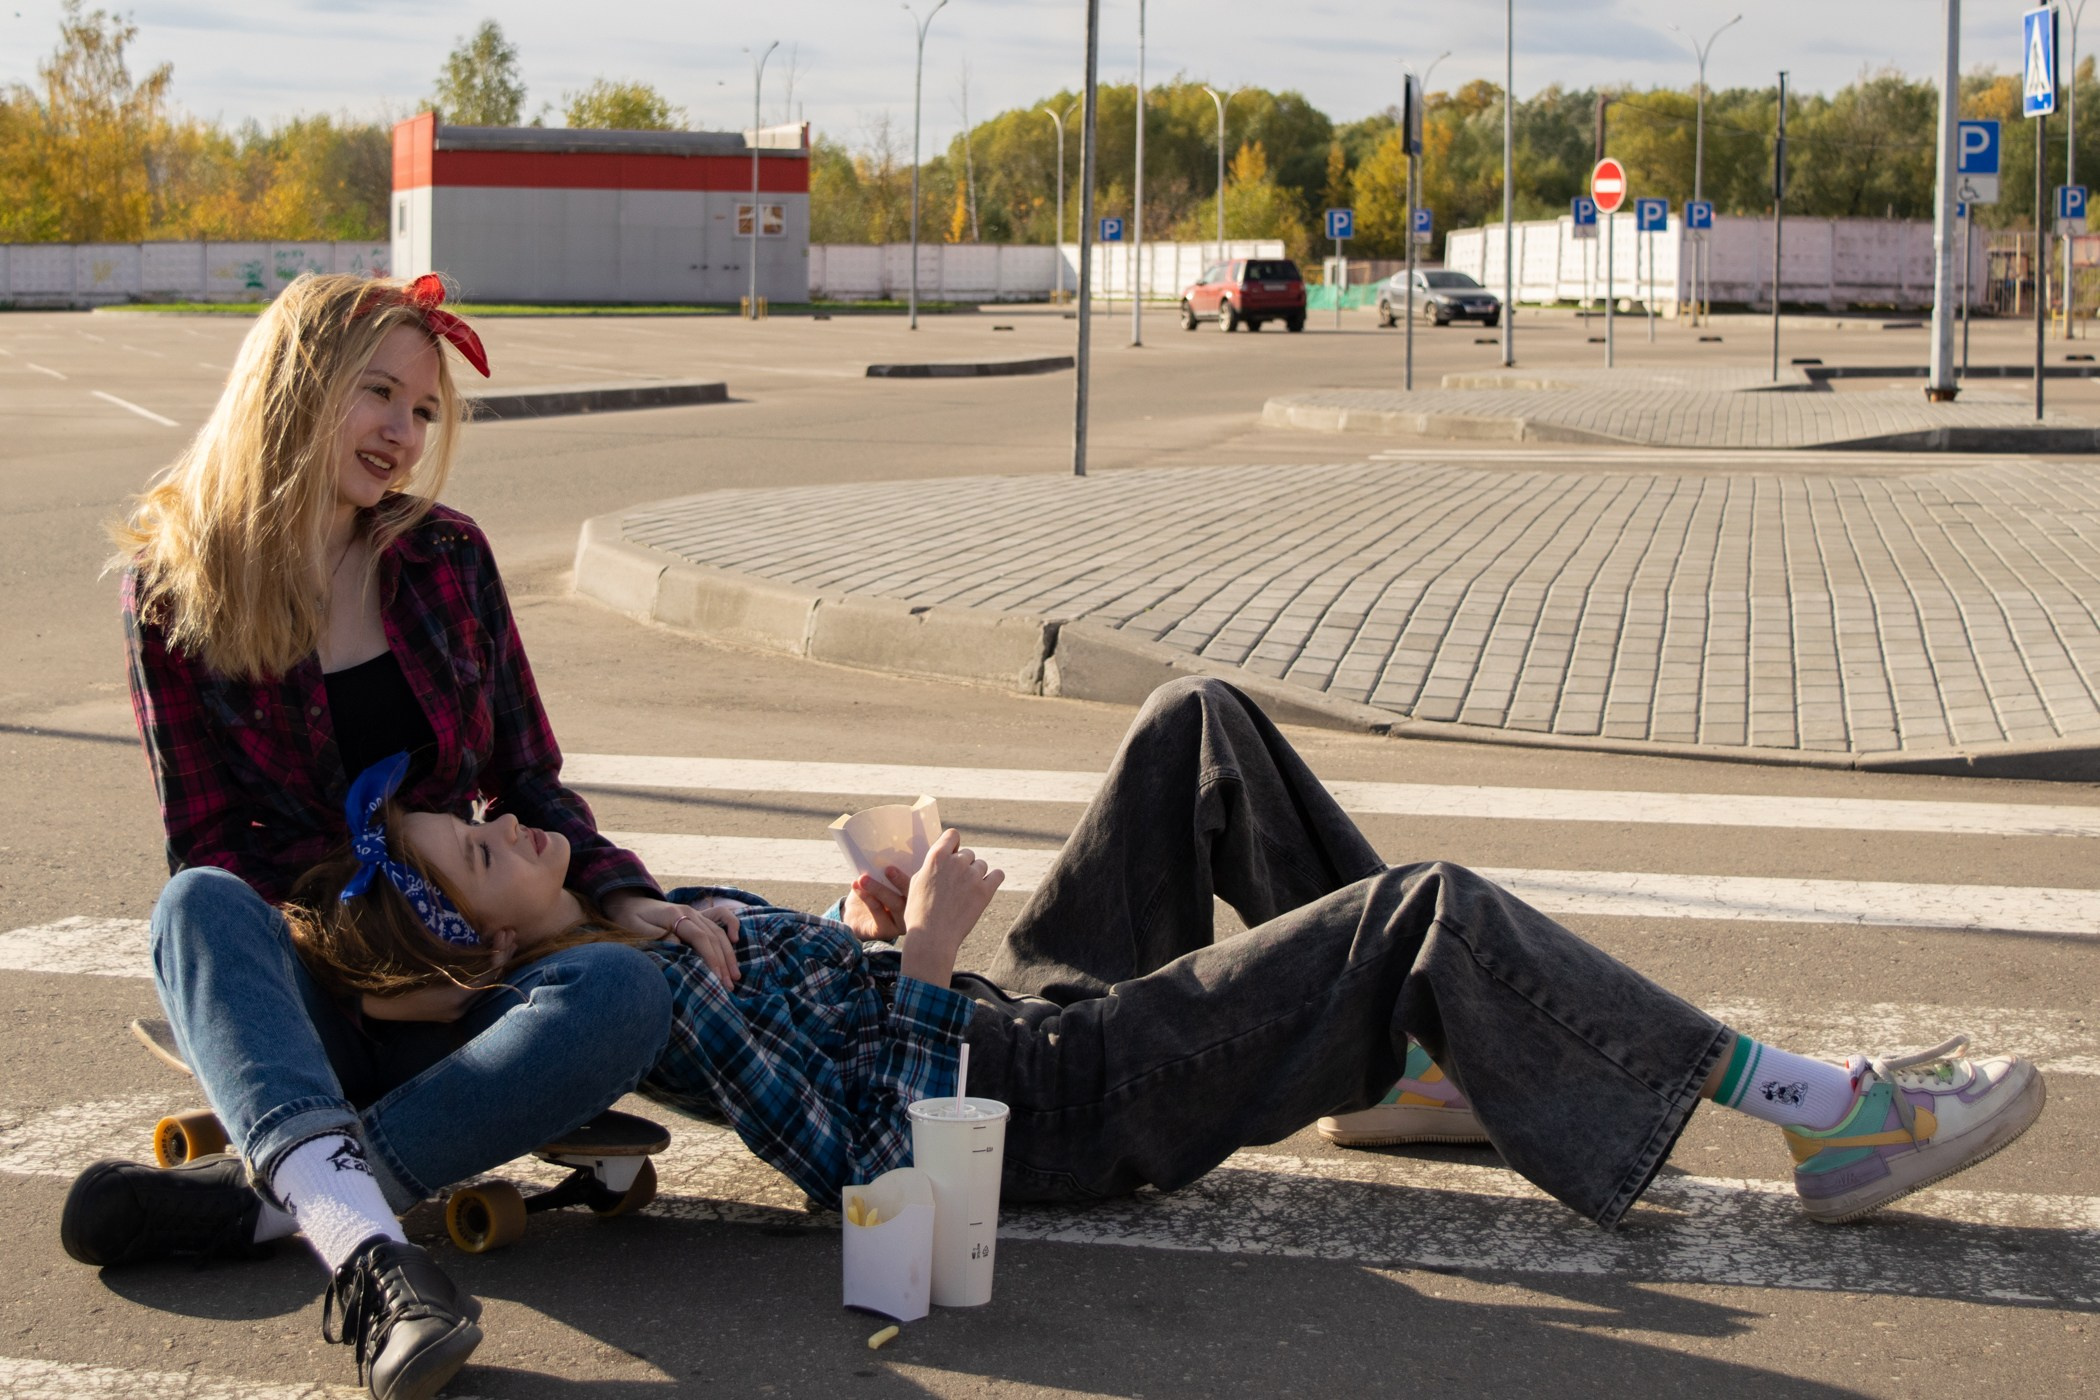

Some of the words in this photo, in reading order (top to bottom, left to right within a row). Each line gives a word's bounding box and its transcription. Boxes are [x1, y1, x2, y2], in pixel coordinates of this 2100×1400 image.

[1959, 125, 1990, 169] P
[1579, 201, 1593, 223] P
[2066, 189, 2082, 216] P
[1333, 213, 1349, 237] P
[1414, 212, 1428, 230] P
[1643, 202, 1662, 229] P
[1693, 204, 1708, 227] P
[1104, 220, 1119, 240] P
